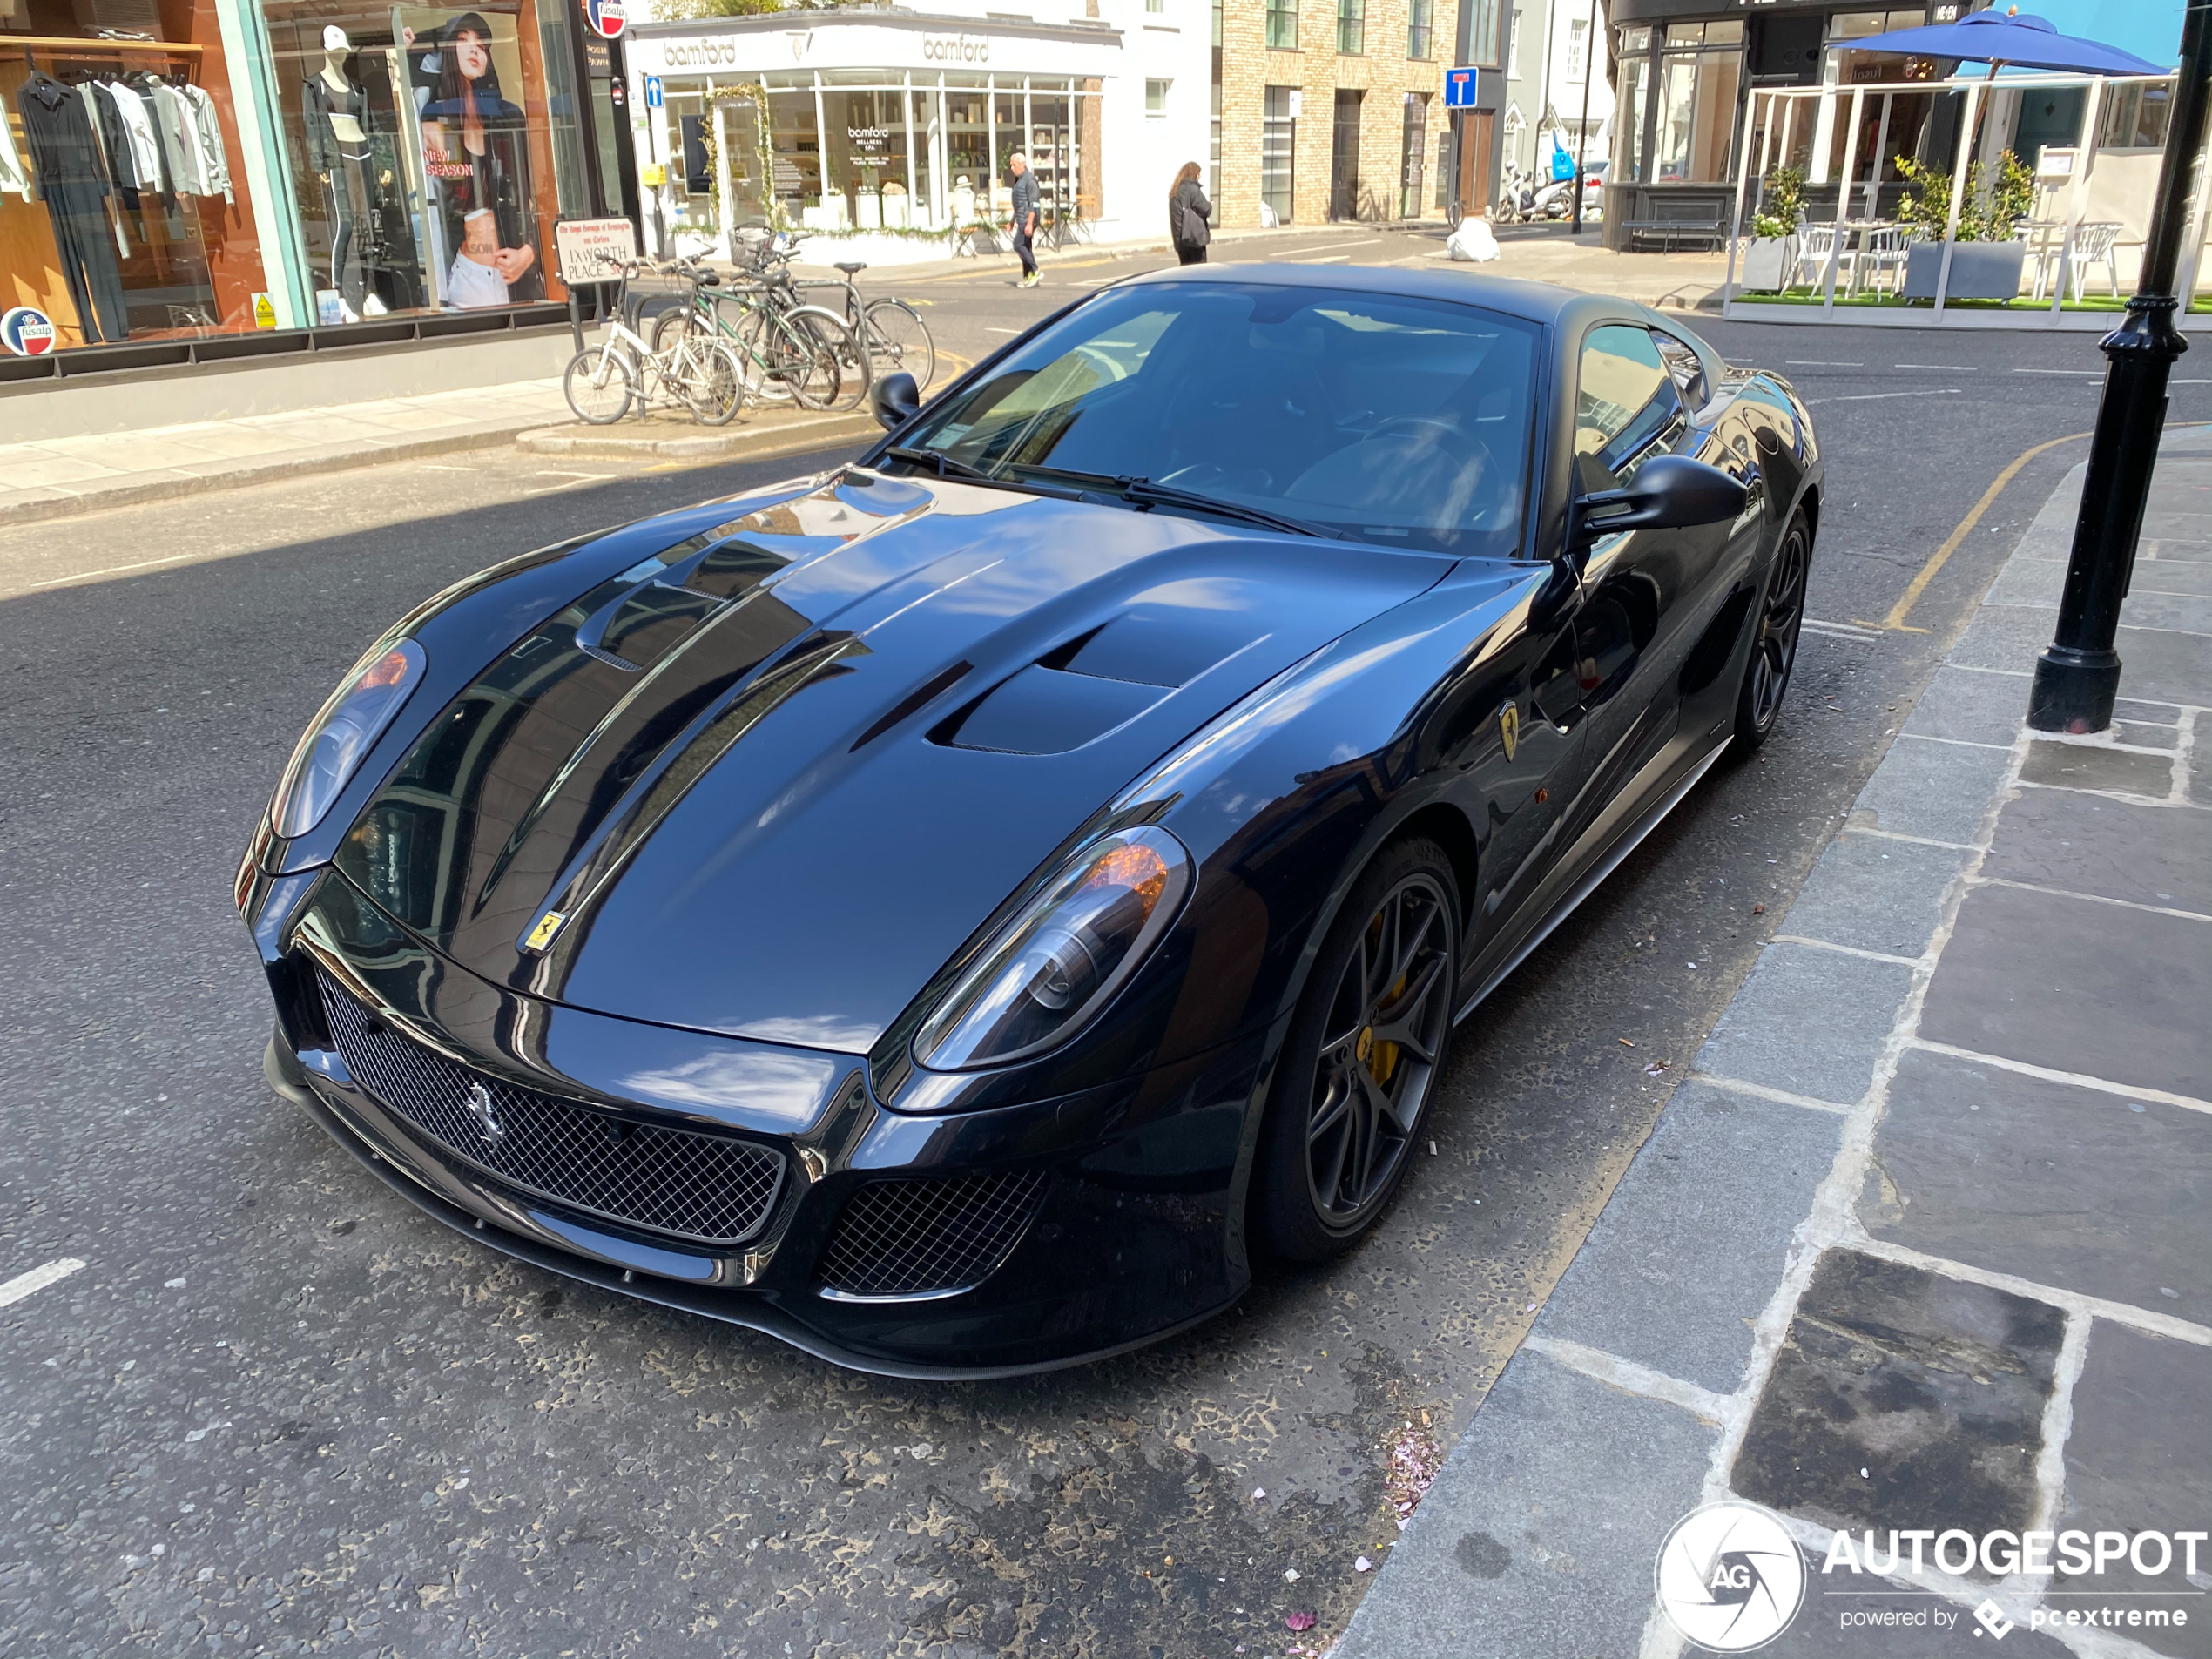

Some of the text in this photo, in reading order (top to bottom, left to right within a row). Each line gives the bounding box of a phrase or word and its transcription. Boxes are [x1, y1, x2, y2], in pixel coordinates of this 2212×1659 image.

[600, 3, 624, 17] fusalp
[586, 45, 607, 54] POSH
[664, 36, 736, 66] bamford
[923, 32, 988, 63] bamford
[588, 57, 609, 66] PAWN
[847, 126, 888, 138] bamford
[424, 150, 450, 162] NEW
[426, 164, 474, 177] SEASON
[570, 246, 627, 263] IXWORTH
[22, 326, 51, 336] fusalp
